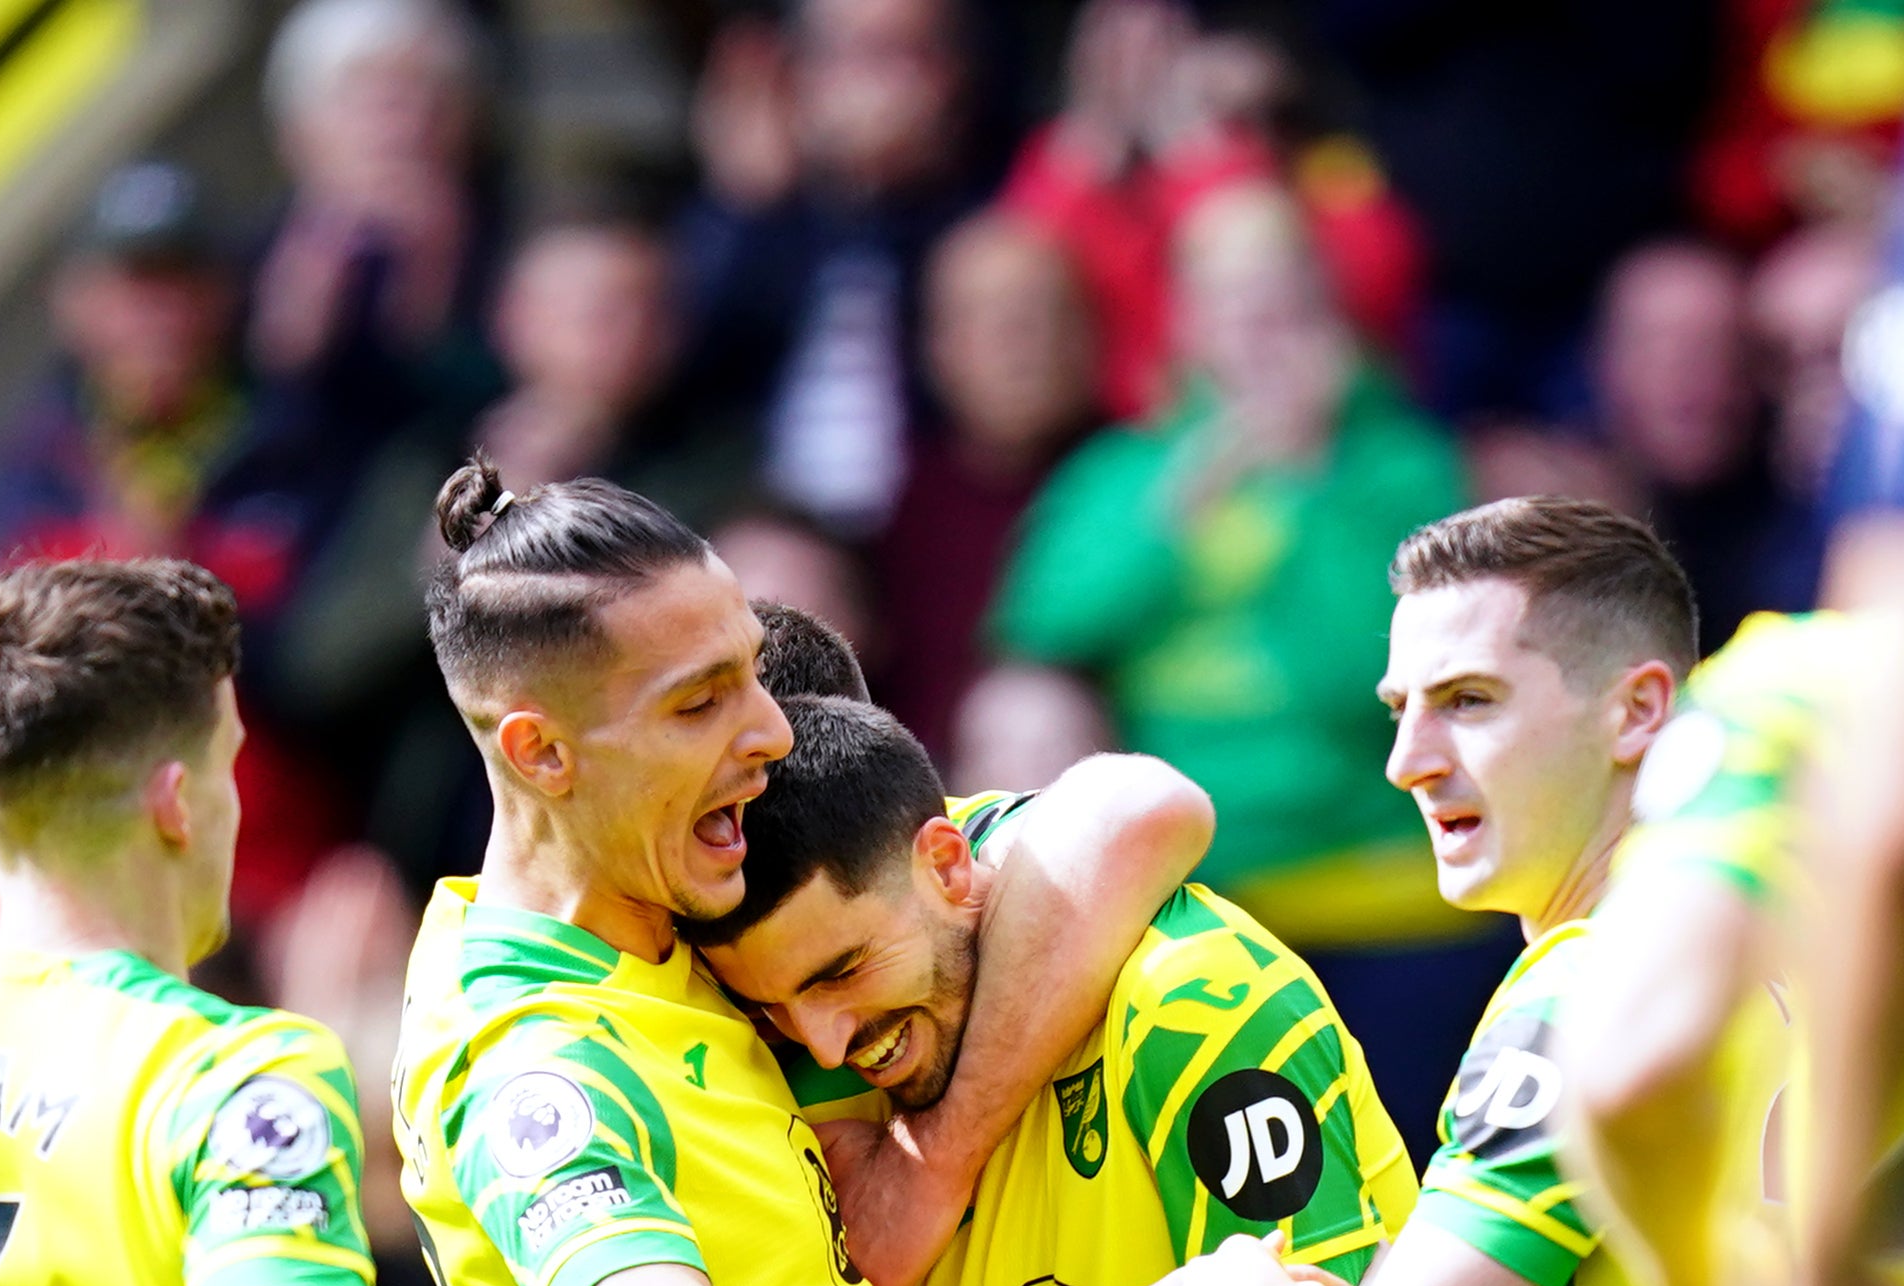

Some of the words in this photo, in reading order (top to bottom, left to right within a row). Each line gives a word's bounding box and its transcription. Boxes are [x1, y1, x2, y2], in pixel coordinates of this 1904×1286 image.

[1456, 1046, 1563, 1129] JD
[1221, 1096, 1305, 1200] JD
[545, 1173, 613, 1211] room
